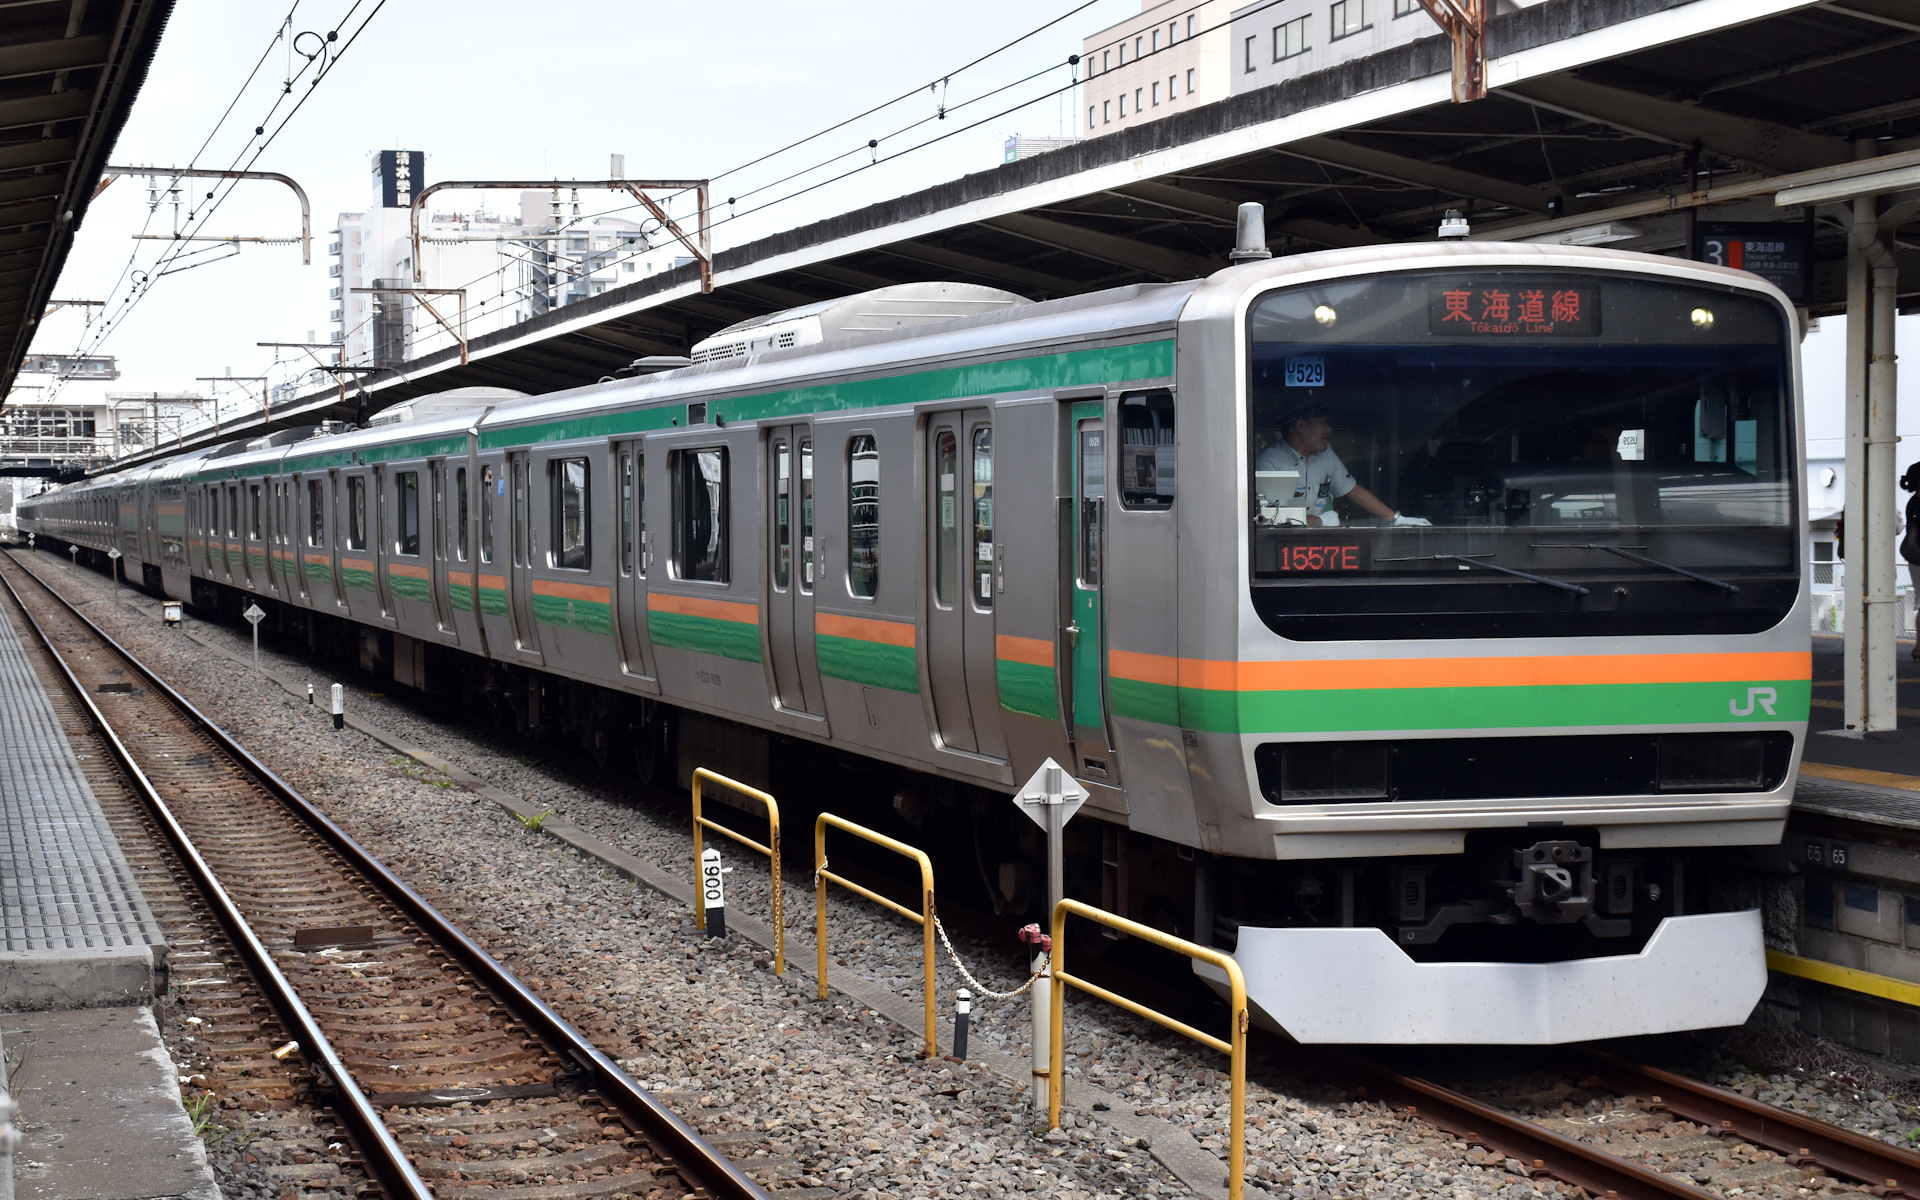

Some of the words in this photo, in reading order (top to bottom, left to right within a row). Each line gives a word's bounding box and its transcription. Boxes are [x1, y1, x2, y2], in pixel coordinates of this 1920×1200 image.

[1706, 240, 1723, 266] 3
[1744, 241, 1785, 253] 東海道線
[1442, 289, 1580, 322] 東海道線
[1526, 322, 1554, 333] Line
[1281, 546, 1359, 570] 1557E
[1729, 687, 1777, 716] JR
[1807, 844, 1821, 862] 65
[1832, 849, 1846, 864] 65
[703, 855, 721, 900] 1900
